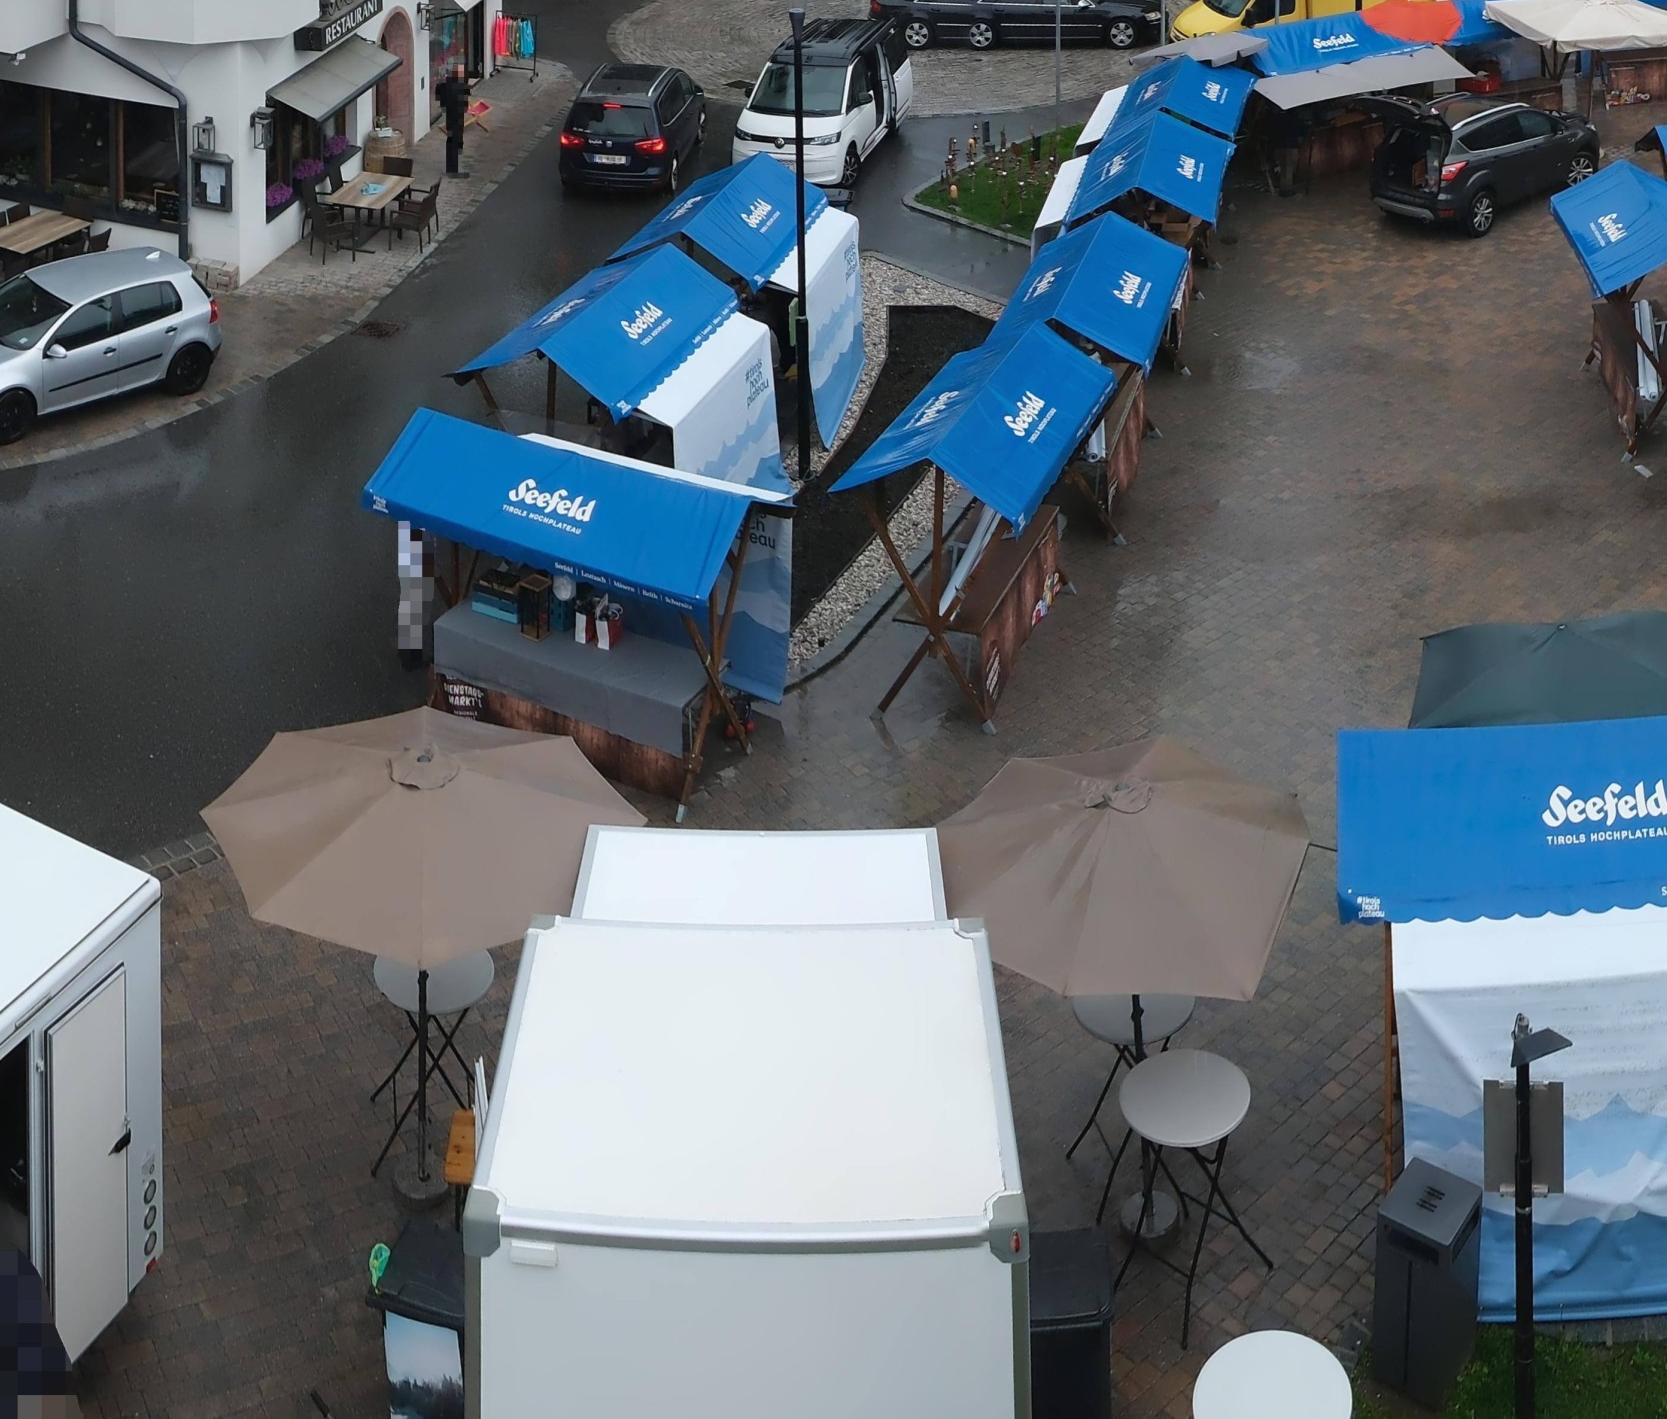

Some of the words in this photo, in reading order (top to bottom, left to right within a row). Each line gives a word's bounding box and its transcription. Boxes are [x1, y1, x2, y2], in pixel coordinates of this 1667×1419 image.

[1313, 33, 1356, 49] Seefeld
[741, 198, 772, 228] Seefeld
[1597, 213, 1628, 242] Seefeld
[1112, 270, 1142, 305] Seefeld
[621, 301, 663, 340] Seefeld
[1004, 390, 1045, 437] Seefeld
[508, 478, 596, 523] Seefeld
[502, 503, 527, 518] TIROLS
[528, 513, 582, 536] HOCHPLATEAU
[1546, 833, 1586, 845] TIROLS
